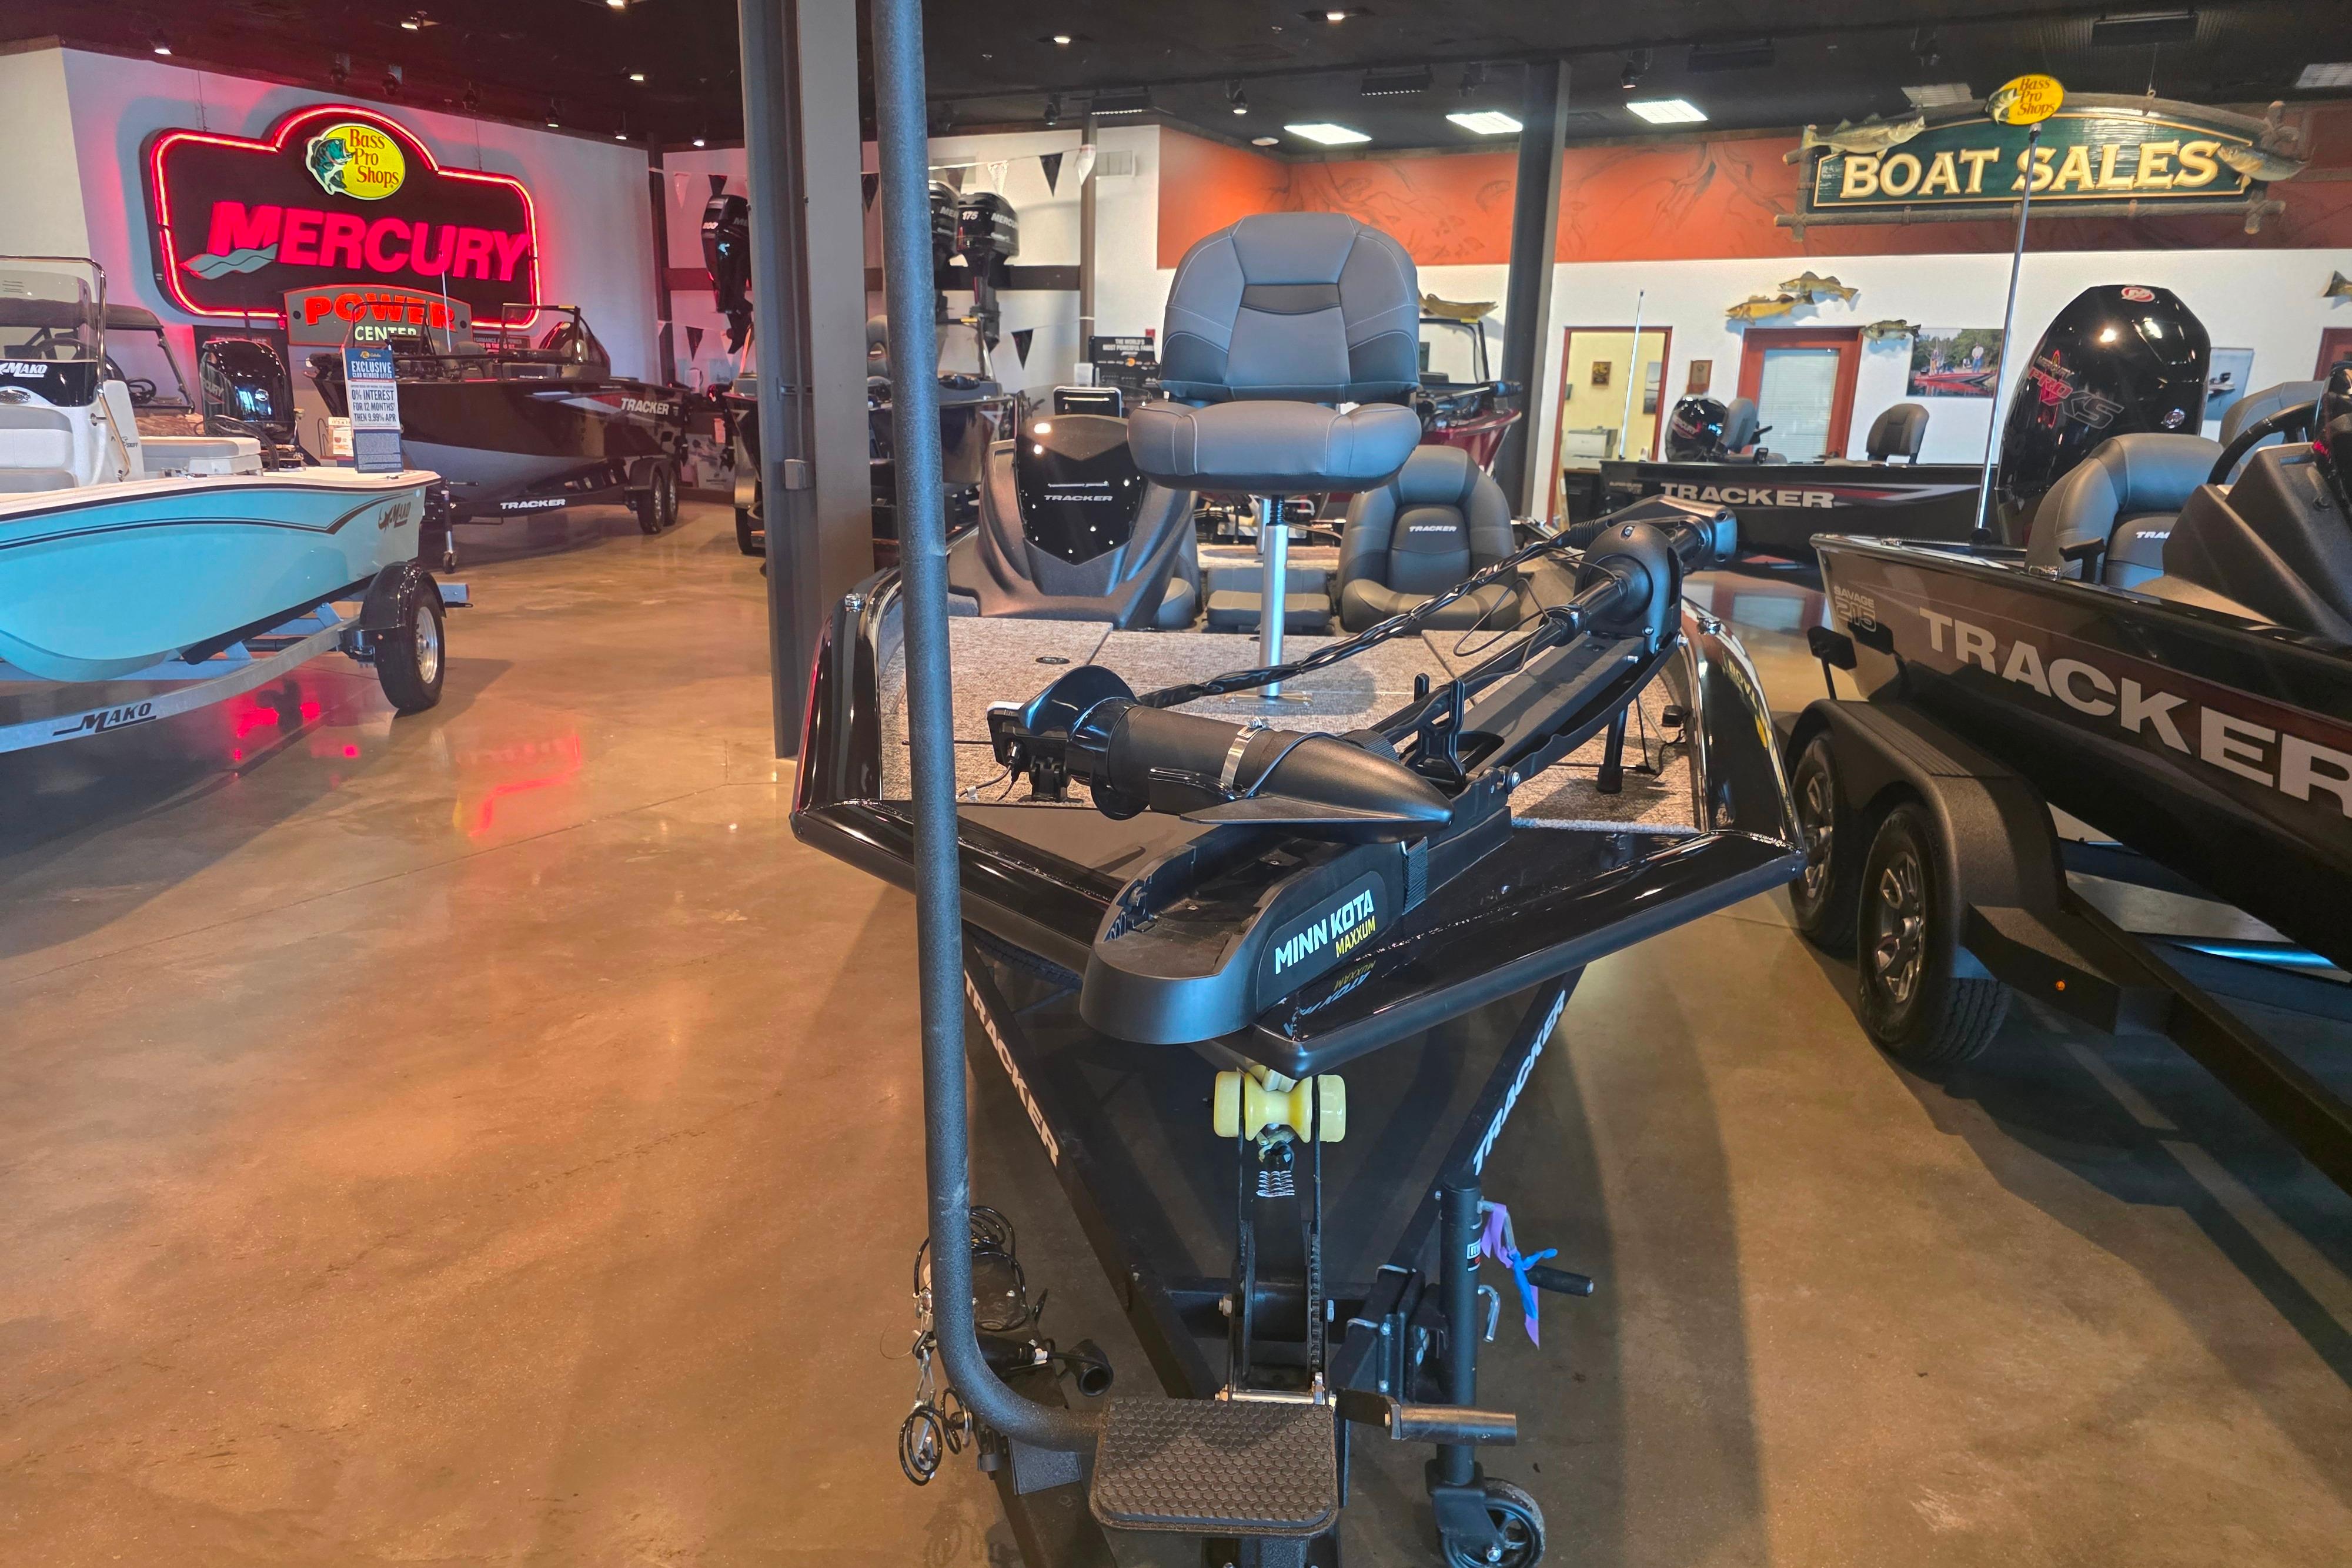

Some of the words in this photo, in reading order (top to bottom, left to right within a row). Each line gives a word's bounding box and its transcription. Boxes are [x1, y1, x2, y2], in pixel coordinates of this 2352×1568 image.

[2020, 78, 2051, 91] Bass
[2020, 91, 2043, 103] Pro
[2017, 103, 2056, 116] Shops
[350, 128, 385, 149] Bass
[354, 148, 379, 166] Pro
[356, 165, 399, 188] Shops
[1840, 148, 1999, 198] BOAT
[2012, 140, 2221, 192] SALES
[962, 210, 979, 220] 175
[207, 200, 530, 281] MERCURY
[305, 293, 458, 333] POWER
[2, 362, 48, 378] MAKO
[351, 360, 392, 373] EXCLUSIVE
[2028, 367, 2073, 400] PRO
[352, 389, 362, 400] 0%
[363, 389, 395, 401] INTEREST
[621, 397, 670, 415] TRACKER
[353, 402, 363, 411] FOR
[364, 402, 370, 411] 12
[353, 413, 368, 422] THEN
[368, 413, 385, 422] 9.99%
[385, 413, 396, 422] APR
[500, 498, 566, 510] TRACKER
[1660, 482, 1835, 509] TRACKER
[1833, 585, 1875, 609] SAVAGE
[52, 702, 157, 737] MAKO
[1919, 607, 2352, 819] TRACKER
[1275, 913, 1328, 975] MINN
[1330, 889, 1374, 940] KOTA
[1335, 915, 1377, 959] MAXXUM
[964, 968, 1059, 1168] TRACKER
[1473, 989, 1566, 1176] TRACKER
